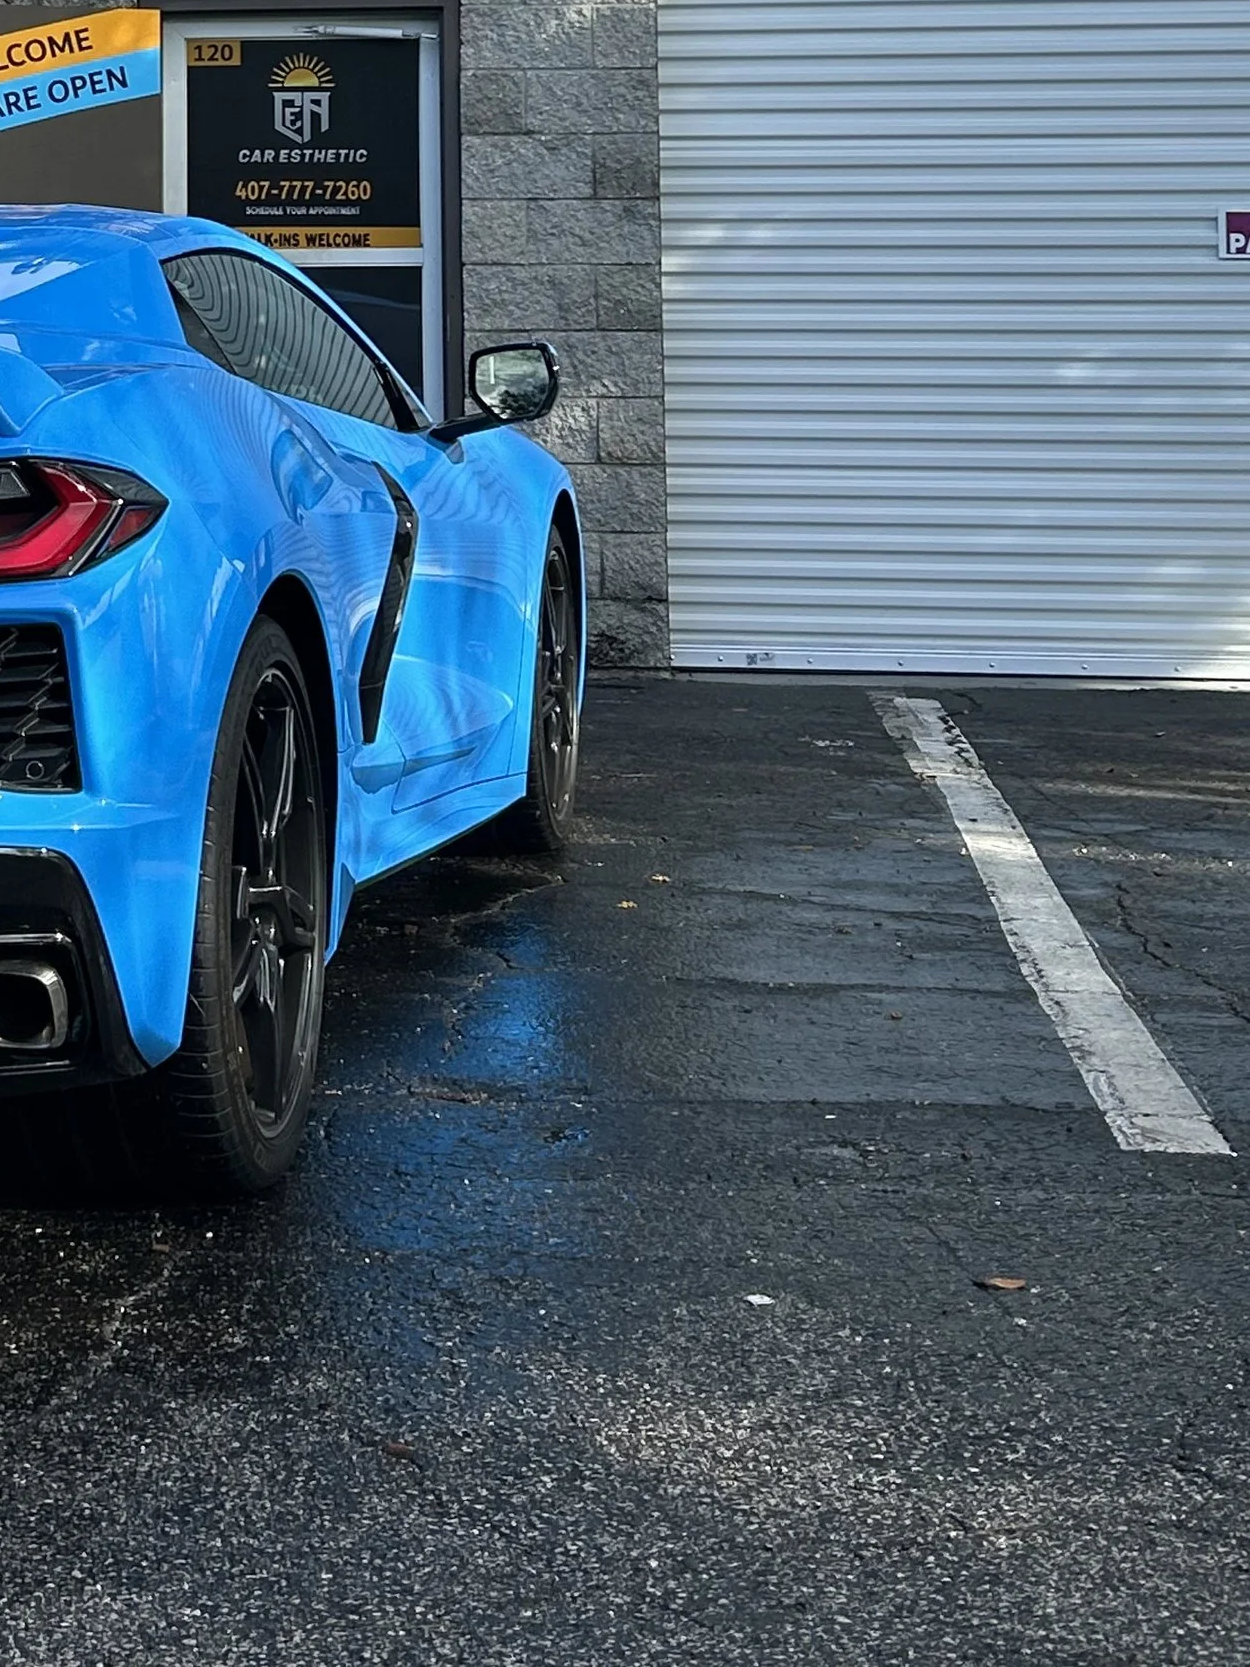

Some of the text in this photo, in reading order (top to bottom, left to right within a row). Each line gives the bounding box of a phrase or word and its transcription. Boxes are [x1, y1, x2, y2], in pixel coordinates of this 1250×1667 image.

[194, 44, 233, 61] 120
[47, 65, 129, 103] OPEN
[238, 149, 368, 163] CAR ESTHETIC
[235, 181, 372, 201] 407-777-7260
[246, 206, 360, 215] SCHEDULE YOUR APPOINTMENT
[305, 233, 371, 248] WELCOME
